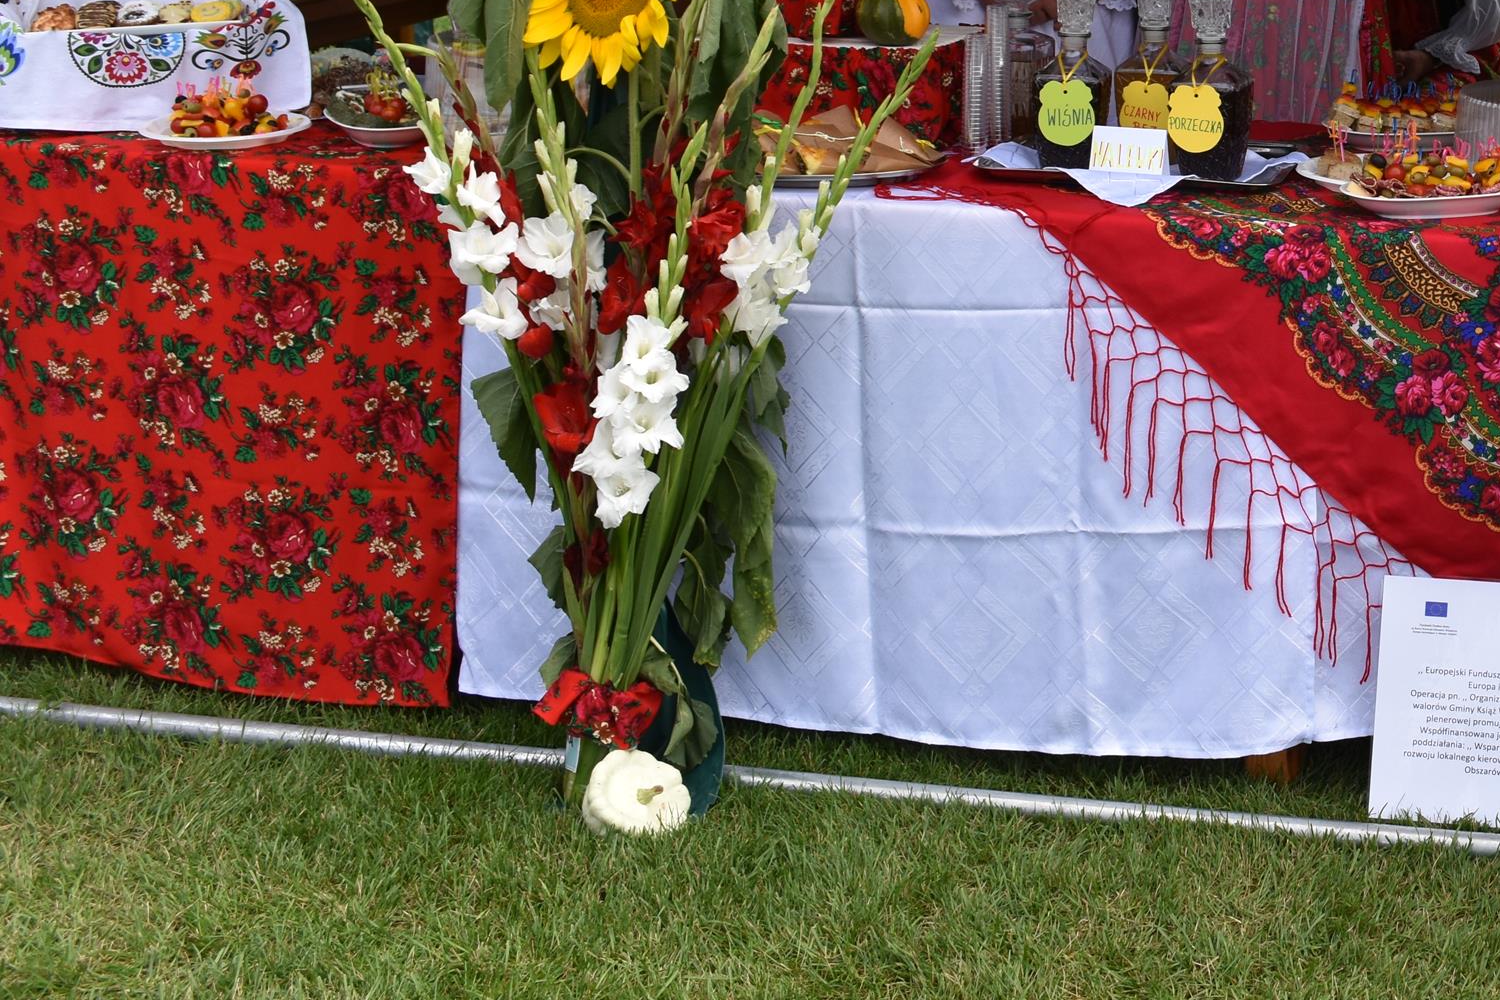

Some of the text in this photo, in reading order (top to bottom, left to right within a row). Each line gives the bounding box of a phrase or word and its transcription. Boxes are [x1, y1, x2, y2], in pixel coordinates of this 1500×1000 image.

[1047, 104, 1093, 127] WIŚNIA
[1124, 104, 1162, 122] CZARNY
[1168, 116, 1222, 134] PORZECZKA
[1425, 666, 1467, 677] Europejski
[1468, 669, 1500, 679] Fundusz
[1468, 681, 1496, 691] Europa
[1410, 689, 1446, 700] Operacja
[1412, 702, 1447, 711] walorów
[1449, 704, 1475, 715] Gminy
[1477, 705, 1497, 716] Książ
[1426, 714, 1471, 727] plenerowej
[1419, 726, 1495, 739] Współfinansowana
[1403, 750, 1436, 760] rozwoju
[1437, 751, 1476, 763] lokalnego
